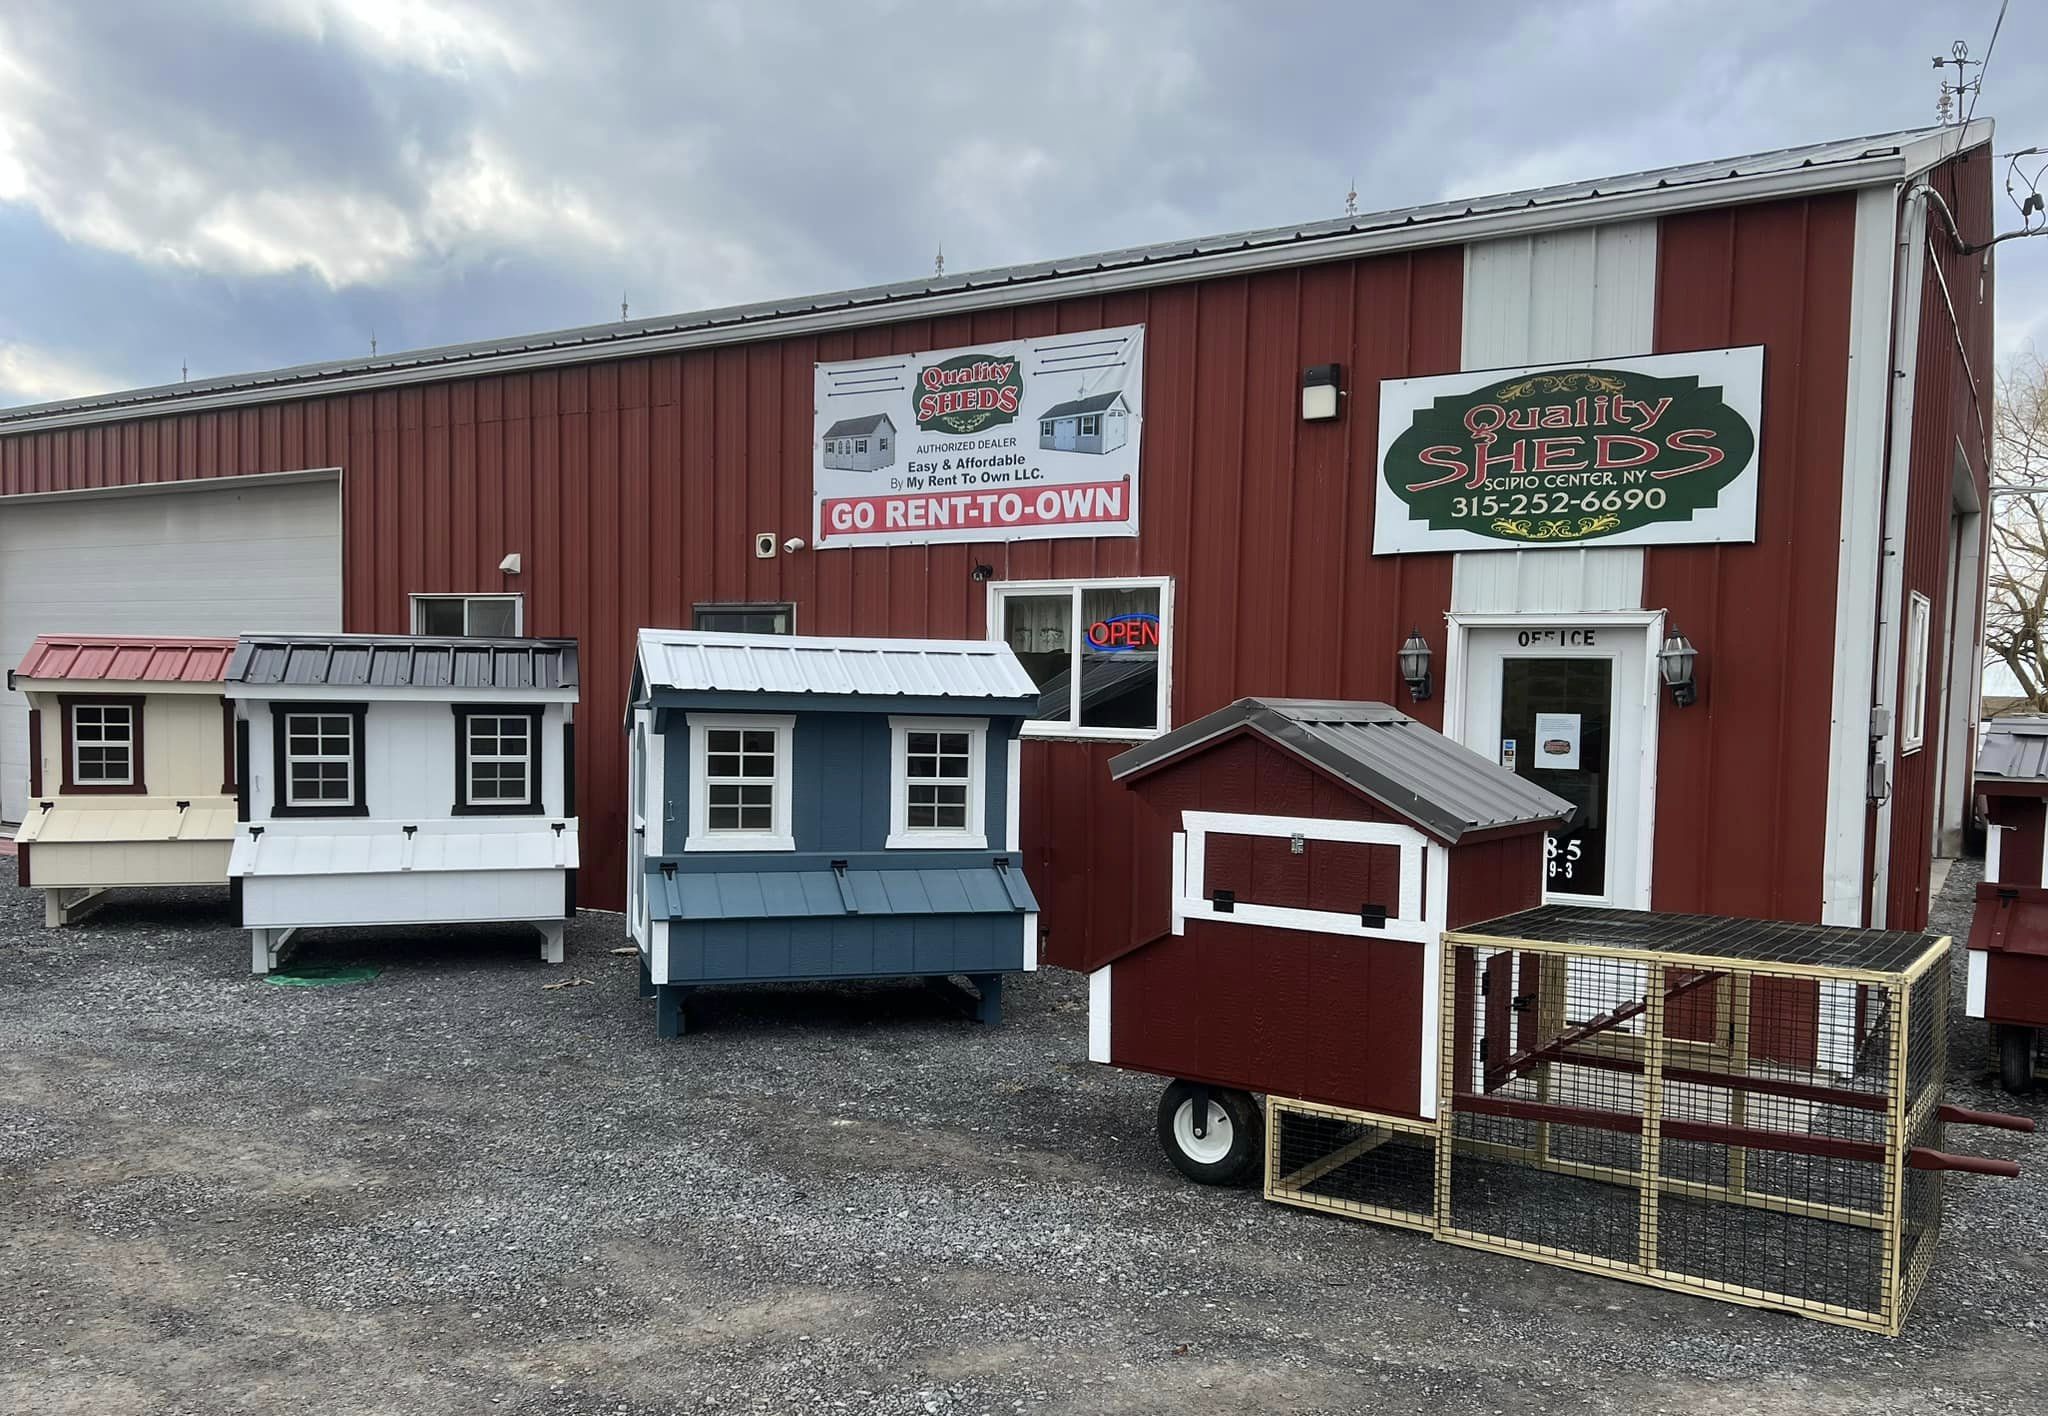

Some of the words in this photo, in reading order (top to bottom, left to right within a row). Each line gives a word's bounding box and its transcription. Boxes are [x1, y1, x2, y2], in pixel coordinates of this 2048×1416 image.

[922, 362, 1014, 392] Quality
[918, 386, 1018, 421] SHEDS
[1463, 395, 1673, 443] Quality
[916, 442, 976, 454] AUTHORIZED
[978, 437, 1017, 449] DEALER
[1405, 428, 1725, 492] SHEDS
[908, 461, 938, 473] Easy
[942, 458, 952, 471] &
[956, 453, 1026, 470] Affordable
[890, 477, 904, 491] By
[906, 477, 925, 490] My
[928, 474, 957, 487] Rent
[961, 473, 977, 485] To
[981, 470, 1010, 483] Own
[1014, 468, 1044, 481] LLC.
[1484, 476, 1540, 492] SCIPIO
[1623, 469, 1648, 485] NY
[831, 502, 875, 530] GO
[886, 487, 1121, 527] RENT-TO-OWN
[1451, 488, 1667, 518] 315-252-6690
[1088, 622, 1159, 646] OPEN
